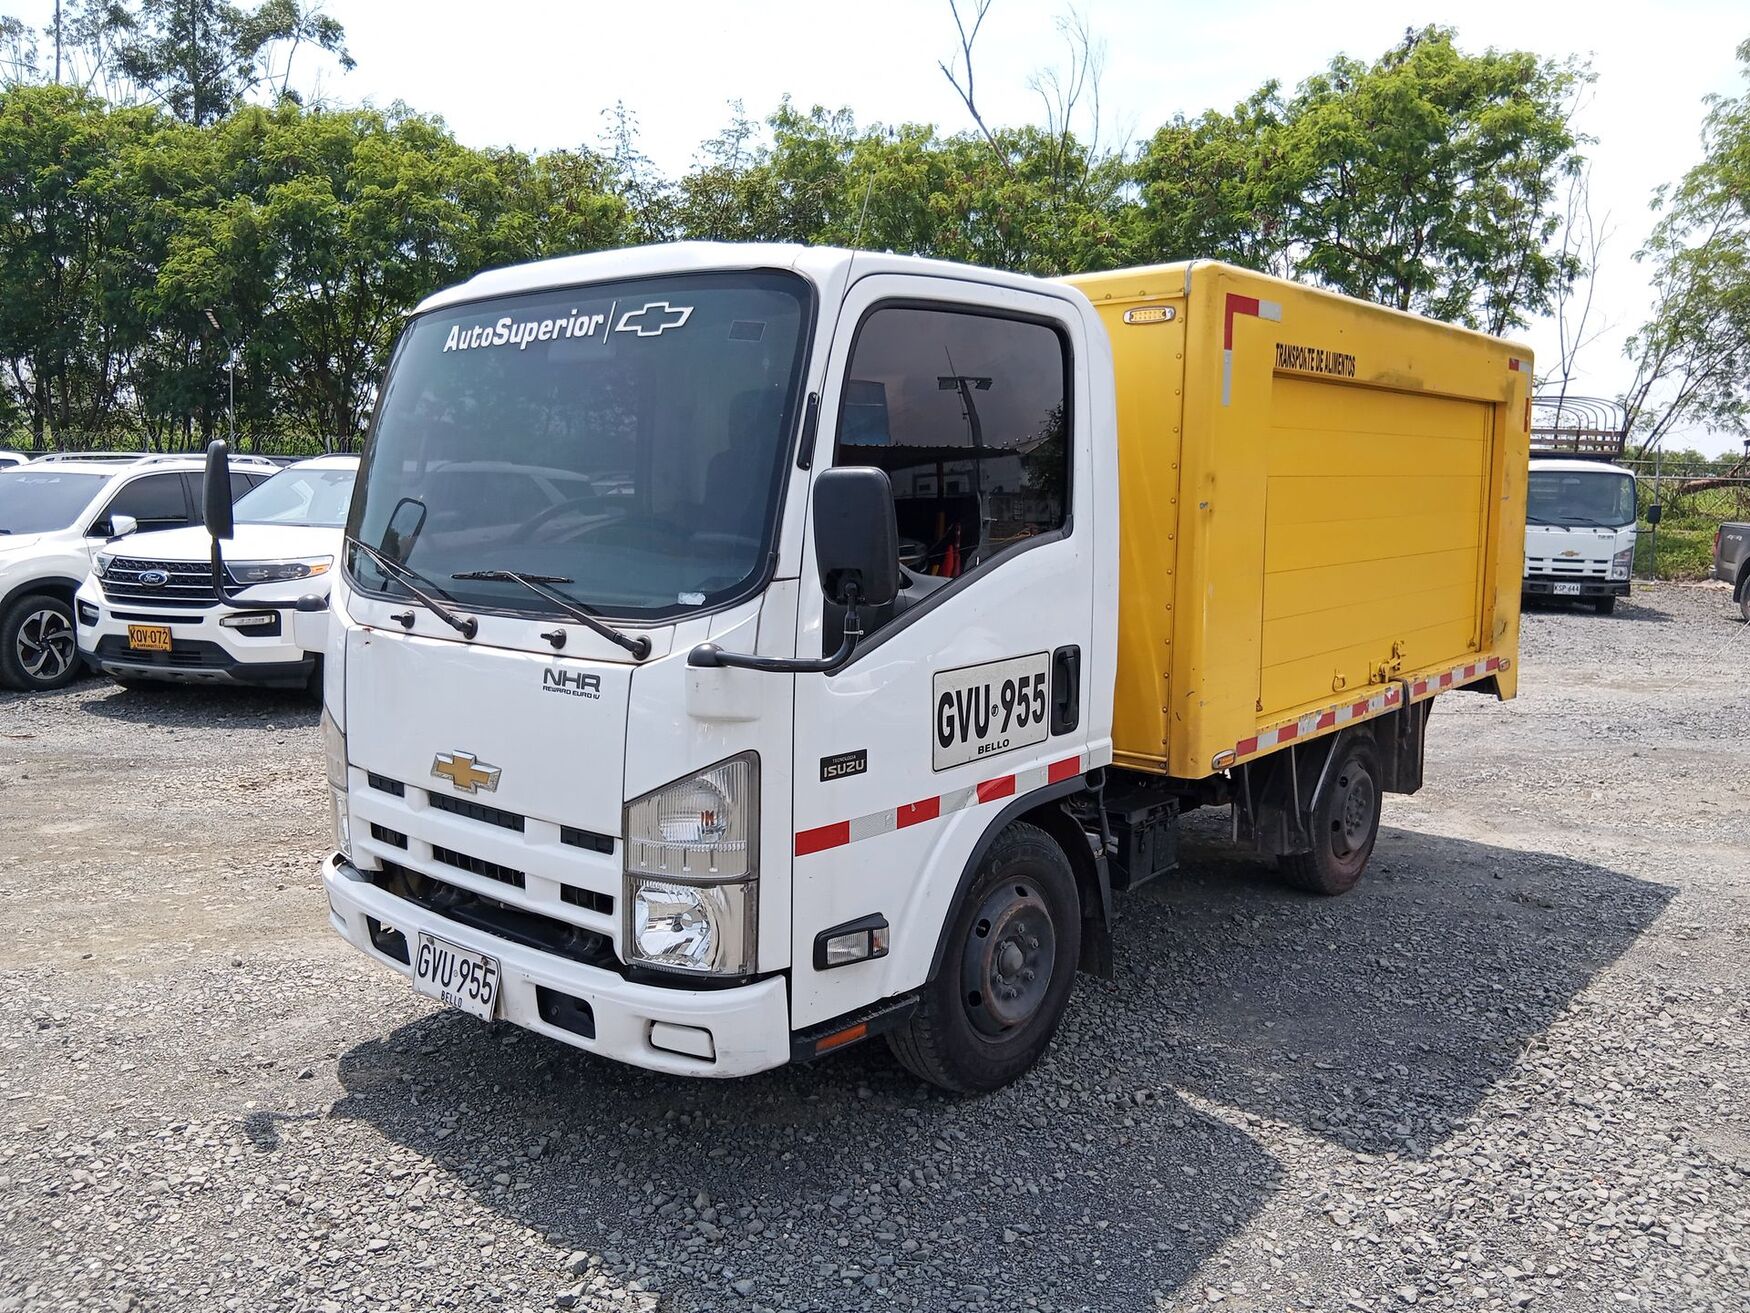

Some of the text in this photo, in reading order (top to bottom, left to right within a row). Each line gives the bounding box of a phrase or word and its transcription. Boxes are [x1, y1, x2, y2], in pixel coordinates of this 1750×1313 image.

[443, 308, 604, 352] AutoSuperior
[1275, 342, 1356, 378] TRANSPORTE DE ALIMENTOS
[144, 574, 160, 583] Ford
[543, 667, 601, 693] NHR
[572, 690, 592, 699] EURO
[978, 739, 1010, 755] BELLO
[823, 759, 865, 778] ISUZU
[440, 990, 463, 1008] BELLO
